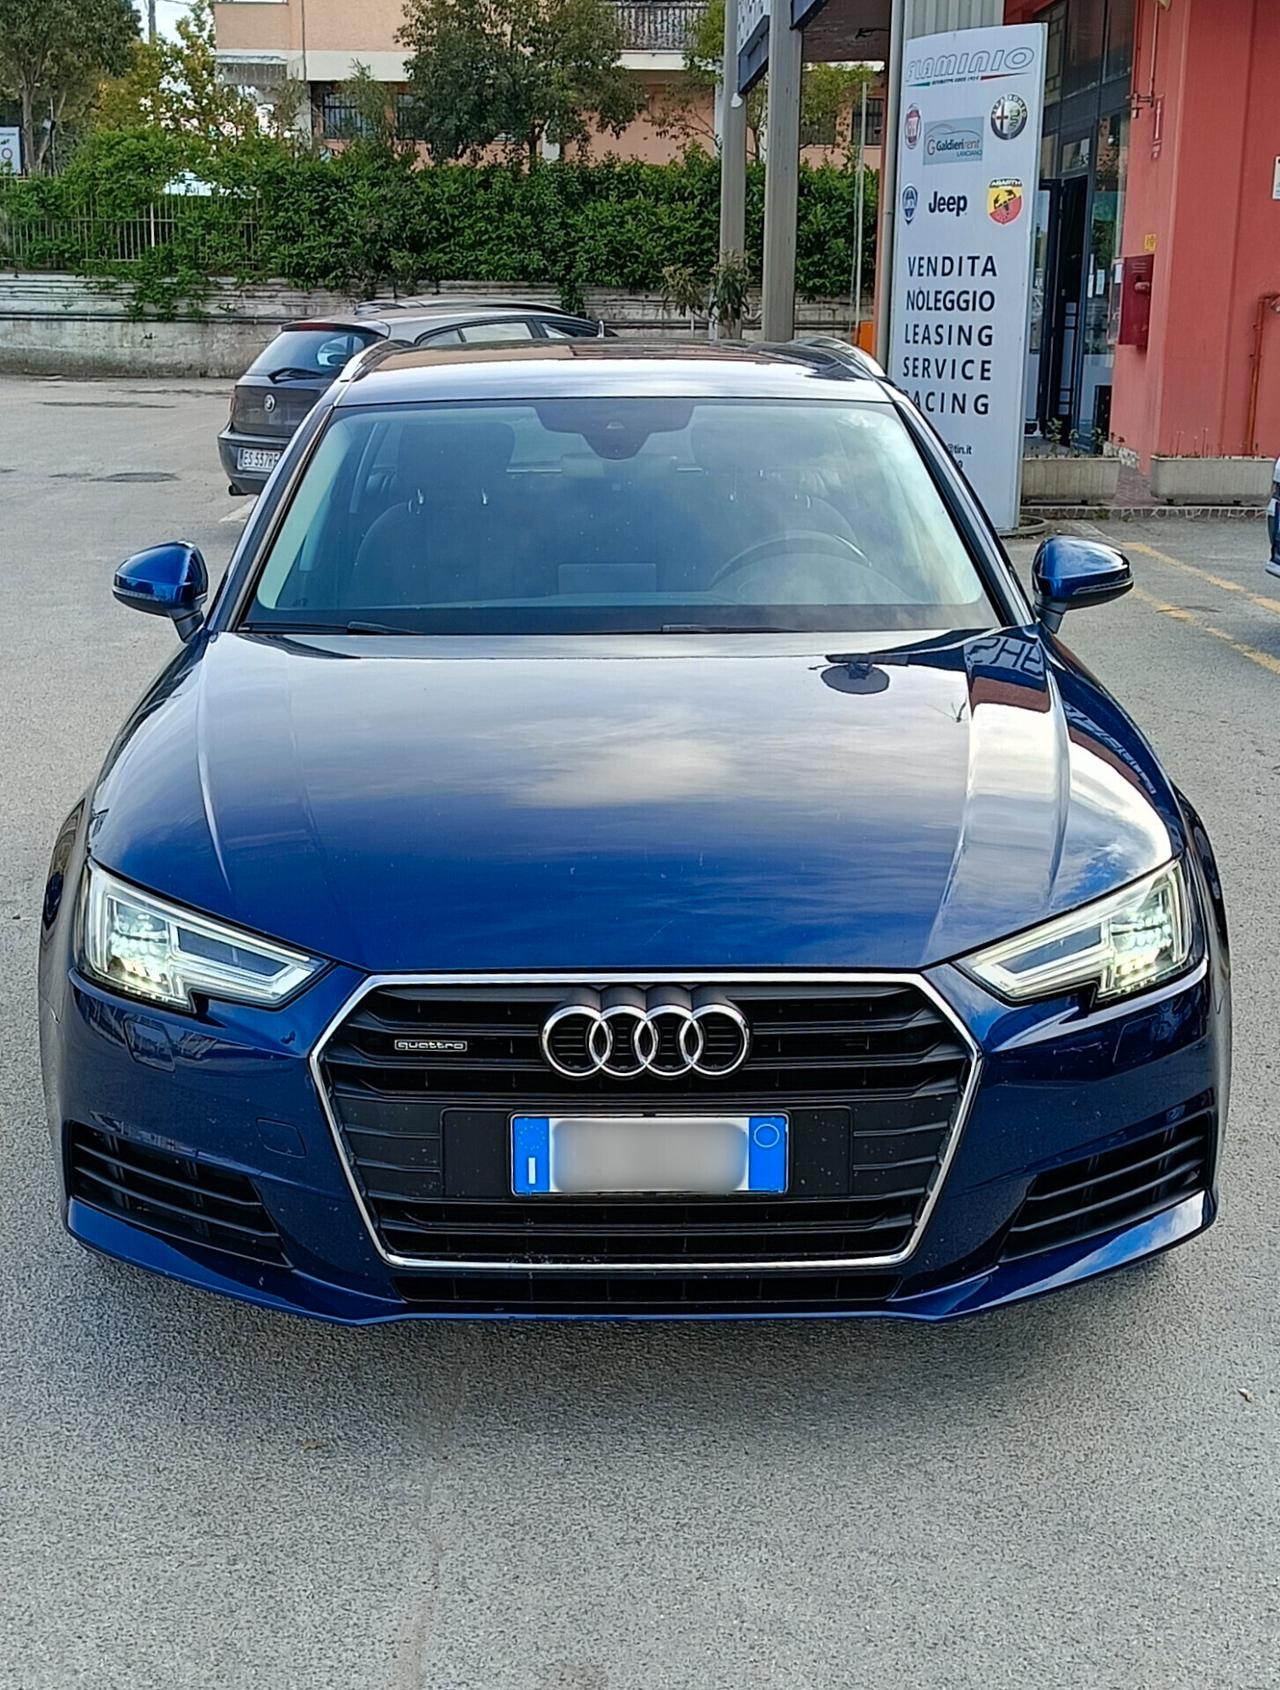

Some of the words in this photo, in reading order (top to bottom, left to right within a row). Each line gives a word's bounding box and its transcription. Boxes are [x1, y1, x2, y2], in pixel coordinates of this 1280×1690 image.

[905, 47, 1034, 81] FLAMINIO
[929, 191, 967, 216] Jeep
[908, 255, 997, 277] VENDITA
[906, 289, 995, 312] NOLEGGIO
[904, 323, 994, 346] LEASING
[903, 356, 992, 381] SERVICE
[903, 388, 989, 415] ACING
[397, 1041, 464, 1050] quattro
